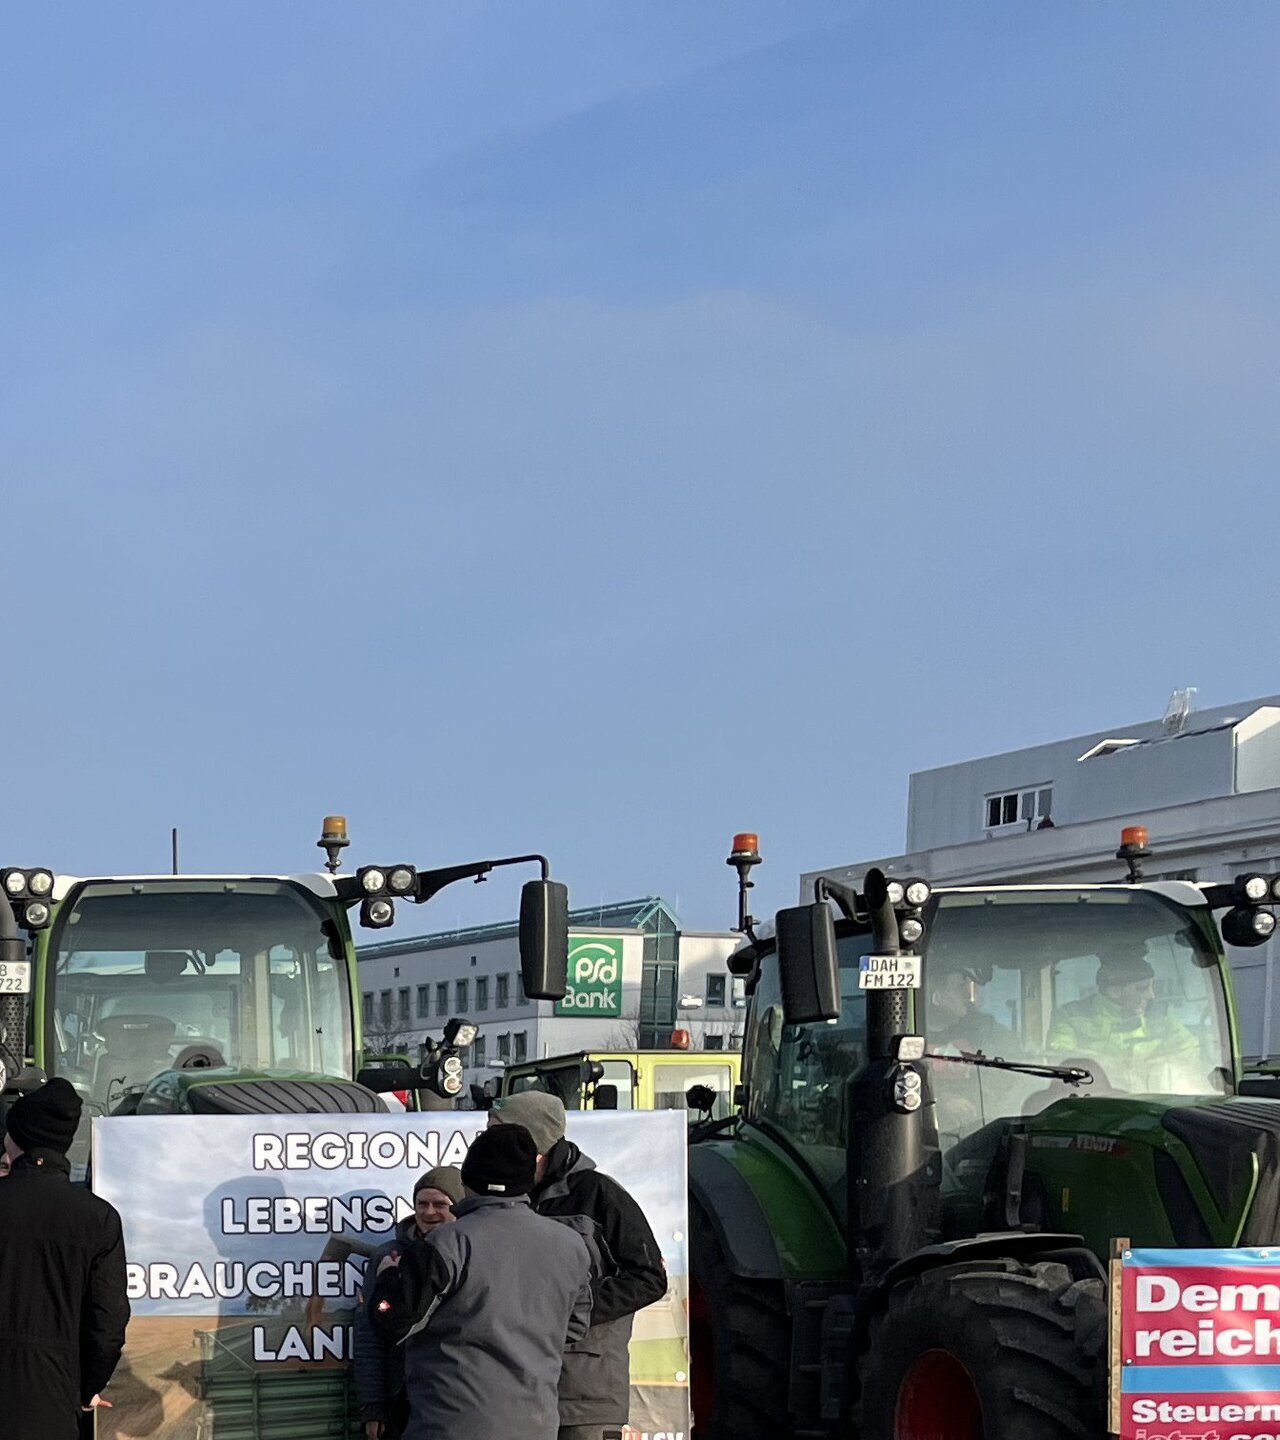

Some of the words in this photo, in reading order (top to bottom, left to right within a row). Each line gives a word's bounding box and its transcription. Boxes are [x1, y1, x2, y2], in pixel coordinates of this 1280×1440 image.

[575, 957, 617, 984] psd
[870, 959, 898, 972] DAH
[864, 974, 884, 987] FM
[887, 974, 915, 987] 122
[561, 985, 617, 1009] Bank
[252, 1131, 482, 1171] REGIONA
[1135, 1275, 1280, 1313] Dem
[252, 1325, 354, 1362] LAN
